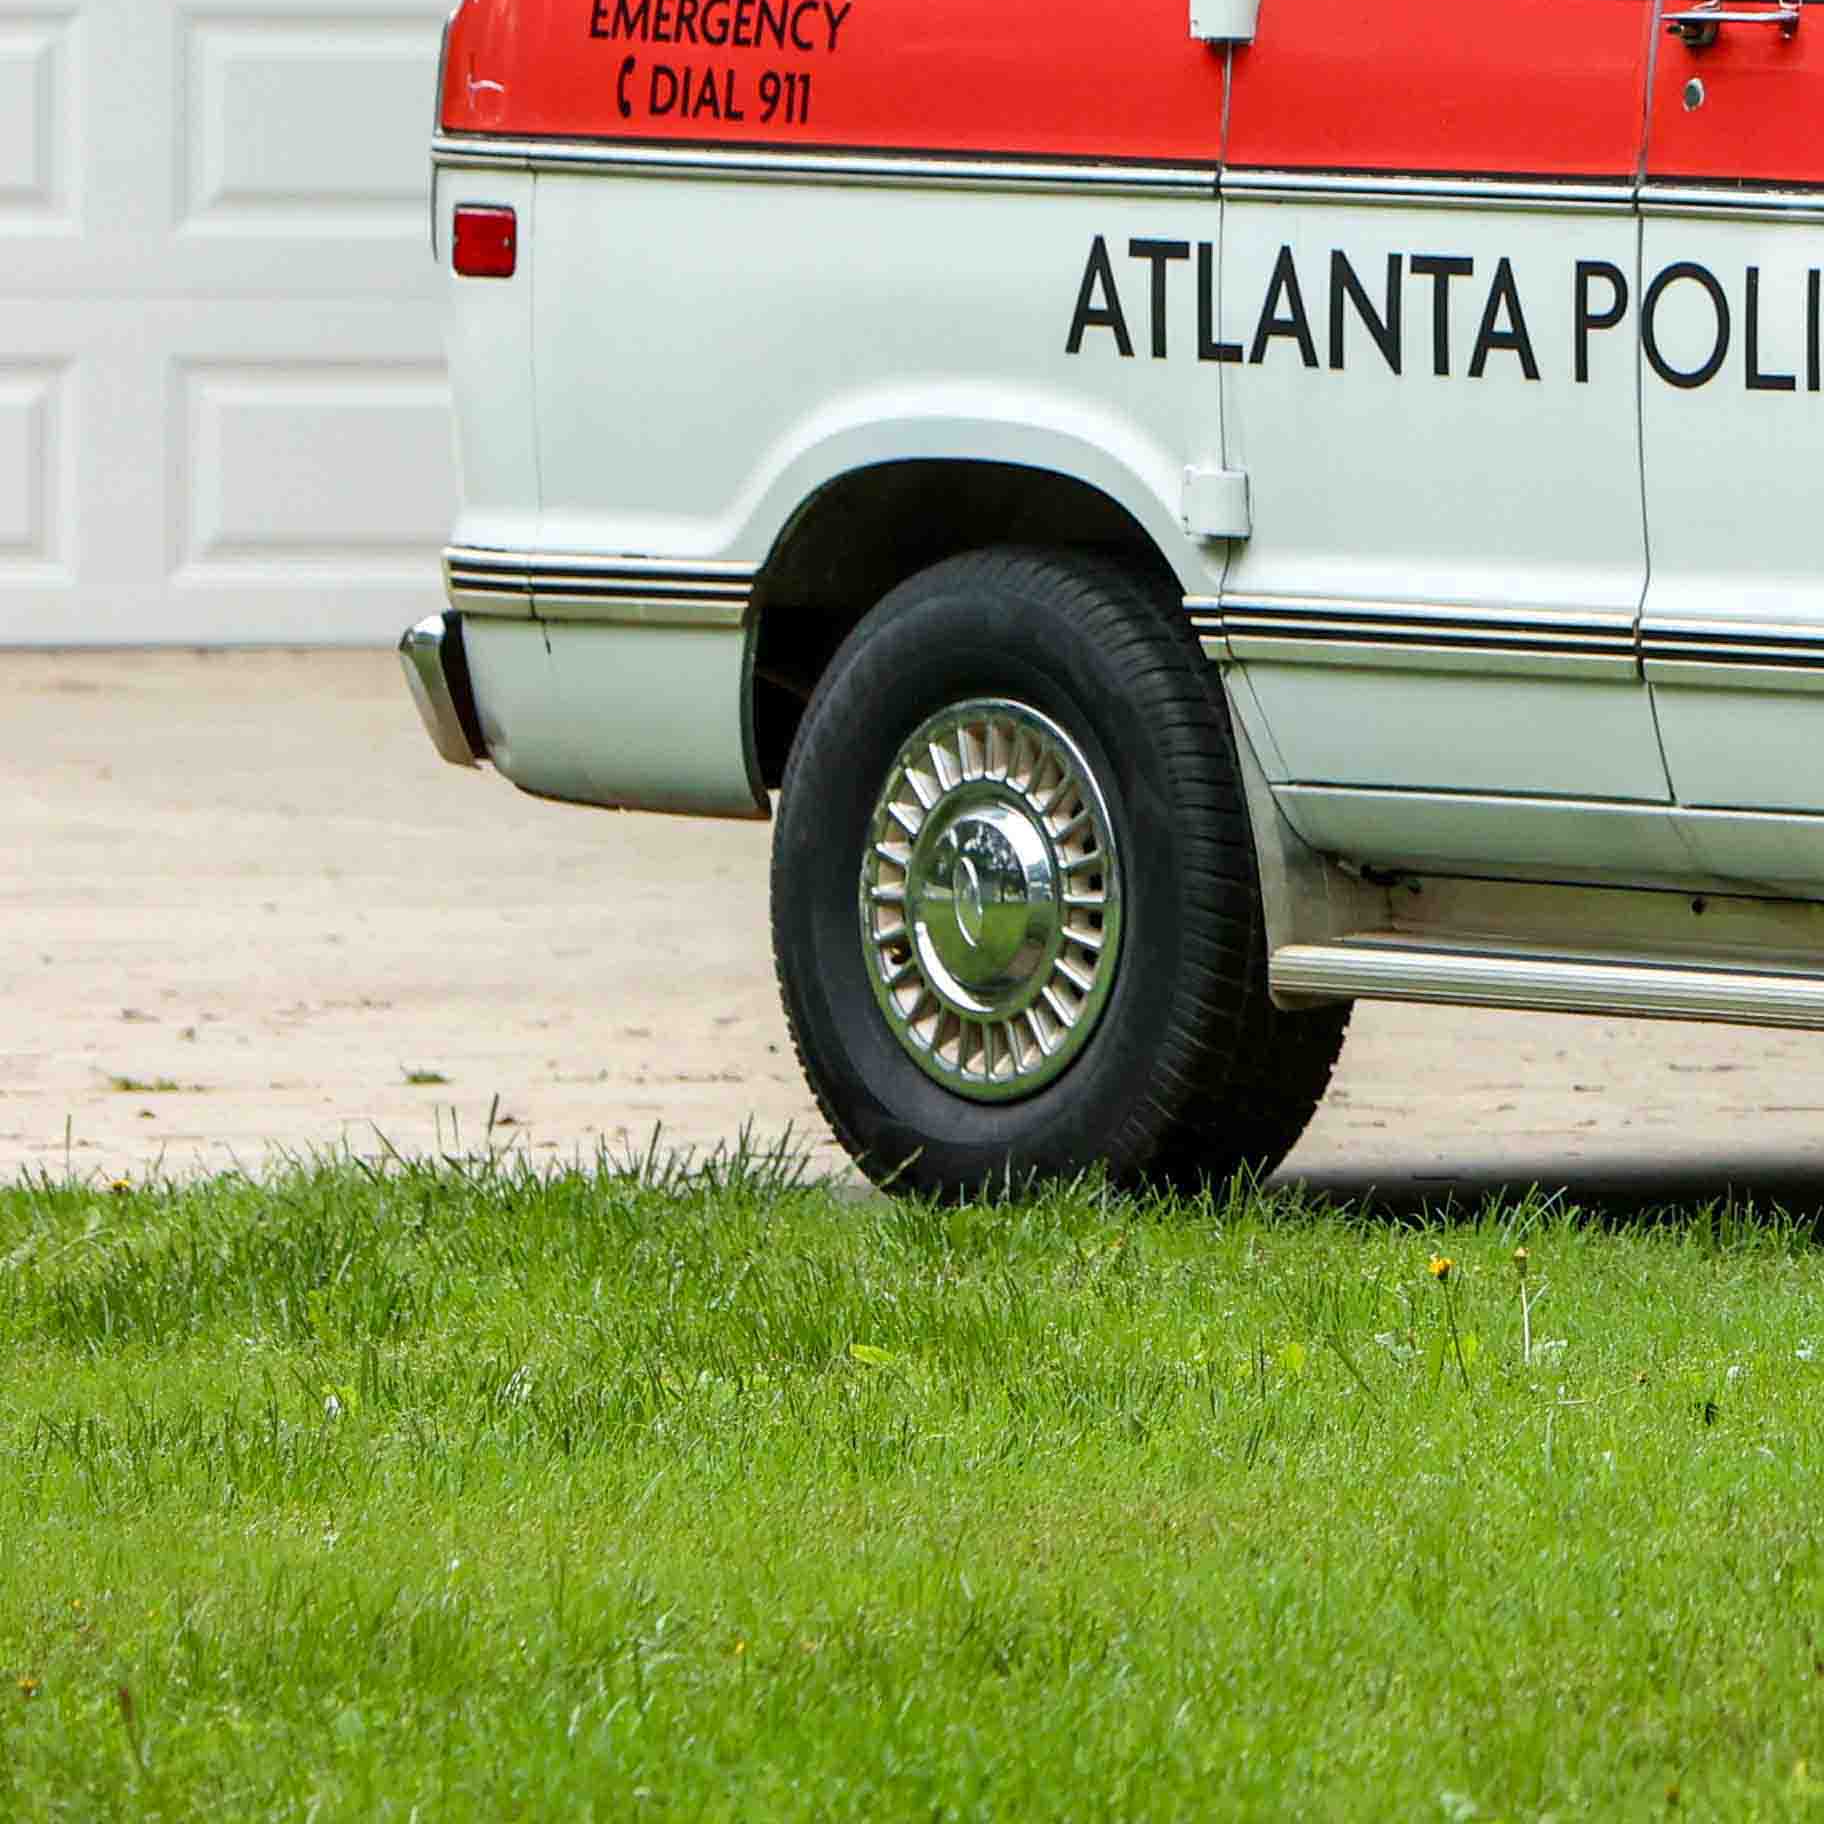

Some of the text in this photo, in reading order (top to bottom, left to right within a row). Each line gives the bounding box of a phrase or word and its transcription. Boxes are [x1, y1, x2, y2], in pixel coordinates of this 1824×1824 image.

[649, 65, 811, 124] DIAL 911
[1065, 235, 1541, 381] ATLANTA
